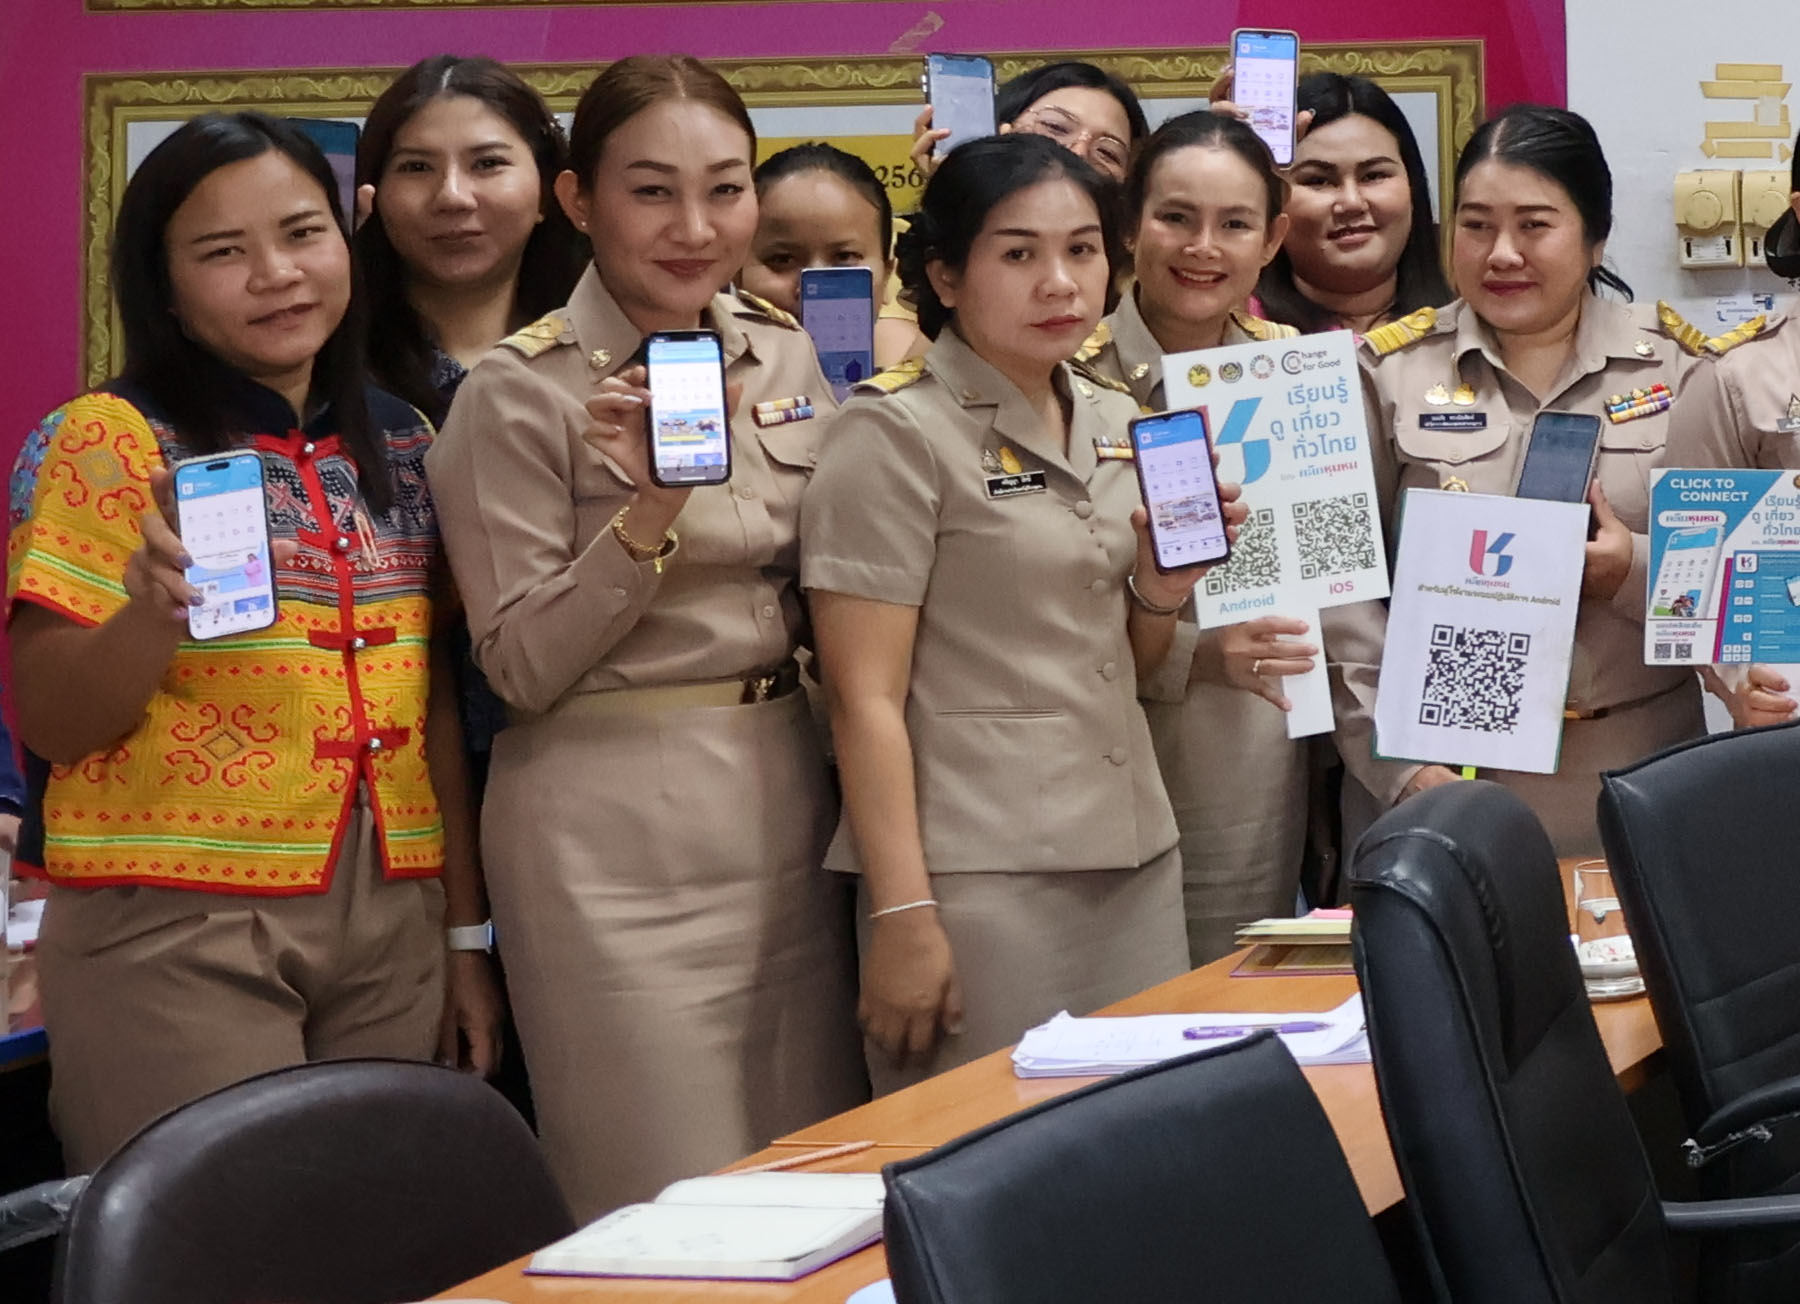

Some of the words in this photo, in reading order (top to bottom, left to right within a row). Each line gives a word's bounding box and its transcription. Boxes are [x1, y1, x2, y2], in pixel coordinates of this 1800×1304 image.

[1317, 359, 1341, 370] Good
[1287, 376, 1349, 406] เรียนรู้
[1270, 419, 1285, 441] ดู
[1292, 403, 1341, 433] เที่ยว
[1292, 433, 1357, 460] ทั่วไทย
[1670, 478, 1712, 490] CLICK
[1714, 478, 1735, 490] TO
[1680, 491, 1749, 503] CONNECT
[1219, 593, 1276, 615] Android
[1530, 595, 1561, 607] Android
